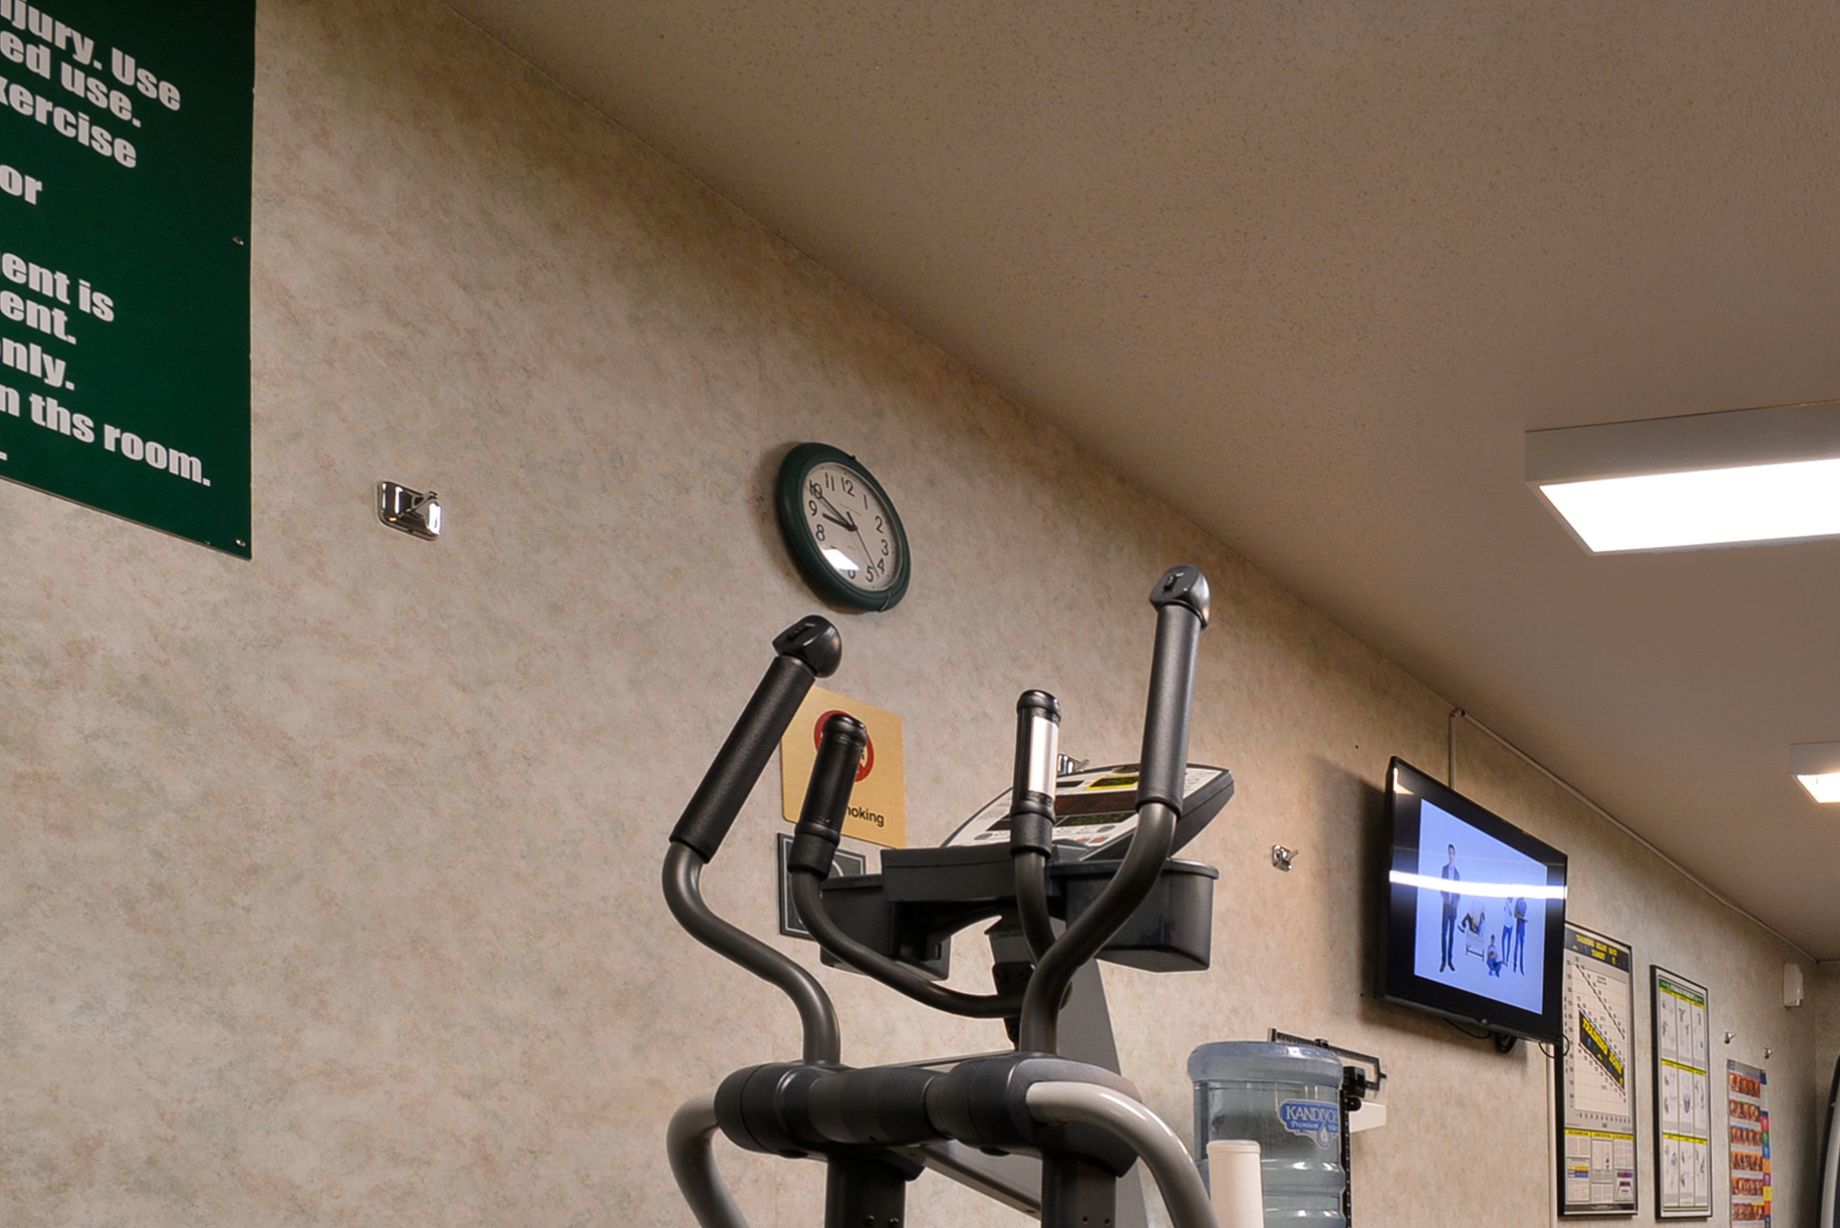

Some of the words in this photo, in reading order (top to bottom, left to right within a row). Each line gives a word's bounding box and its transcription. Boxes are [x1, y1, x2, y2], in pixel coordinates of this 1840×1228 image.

[0, 0, 102, 70] jury.
[111, 47, 181, 111] Use
[61, 62, 141, 128] use.
[0, 164, 43, 204] or
[78, 279, 115, 322] is
[0, 337, 75, 391] nly.
[29, 393, 95, 444] ths
[104, 423, 211, 487] room.
[825, 472, 835, 491] 11
[841, 476, 856, 497] 12
[808, 500, 817, 517] 9
[815, 523, 825, 541] 8
[874, 515, 884, 534] 2
[880, 539, 889, 556] 3
[866, 565, 875, 582] 5
[876, 558, 885, 575] 4
